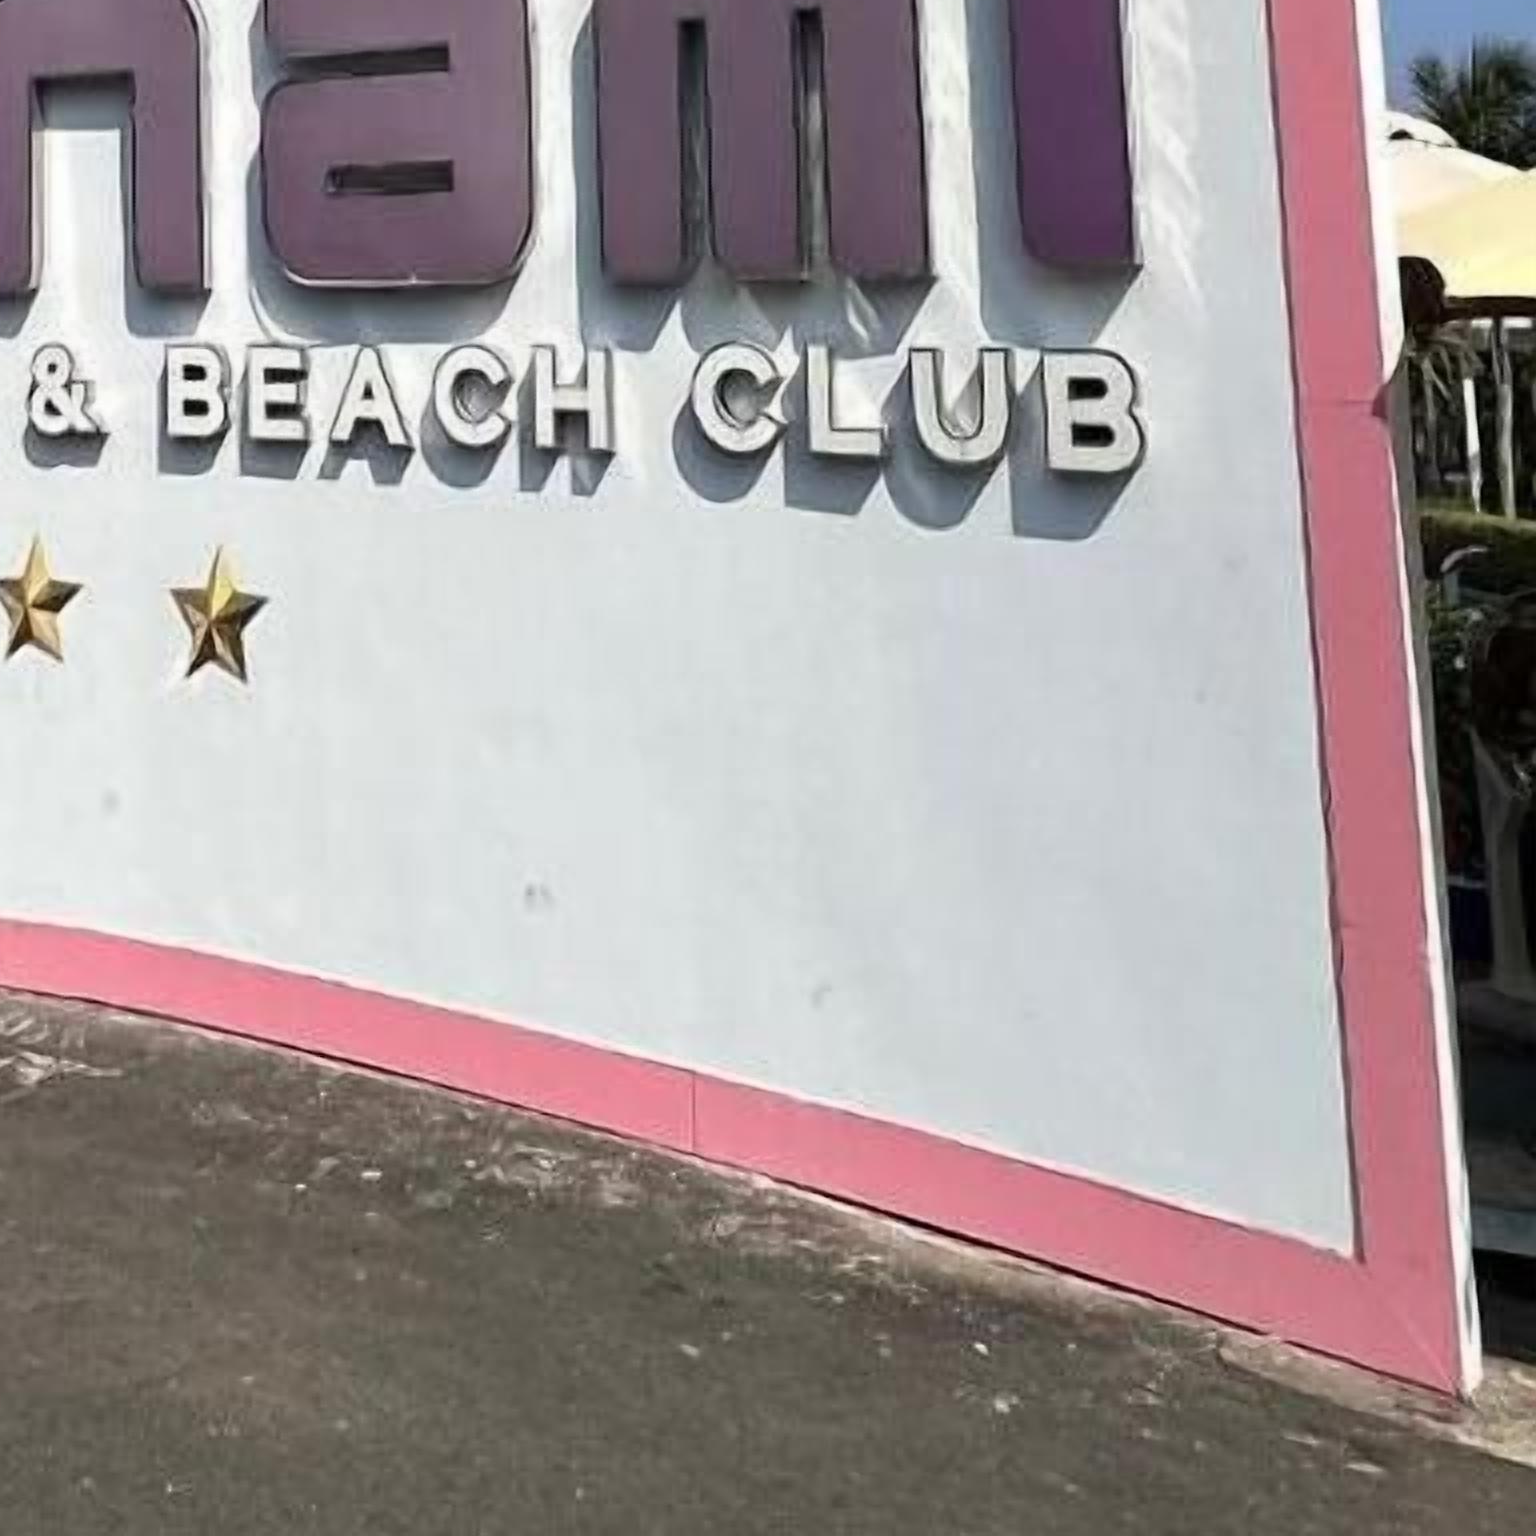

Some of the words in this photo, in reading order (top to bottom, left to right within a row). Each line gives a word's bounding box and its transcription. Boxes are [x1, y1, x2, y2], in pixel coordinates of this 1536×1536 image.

[28, 343, 104, 441] &
[163, 342, 614, 454] BEACH
[690, 340, 1146, 474] CLUB
